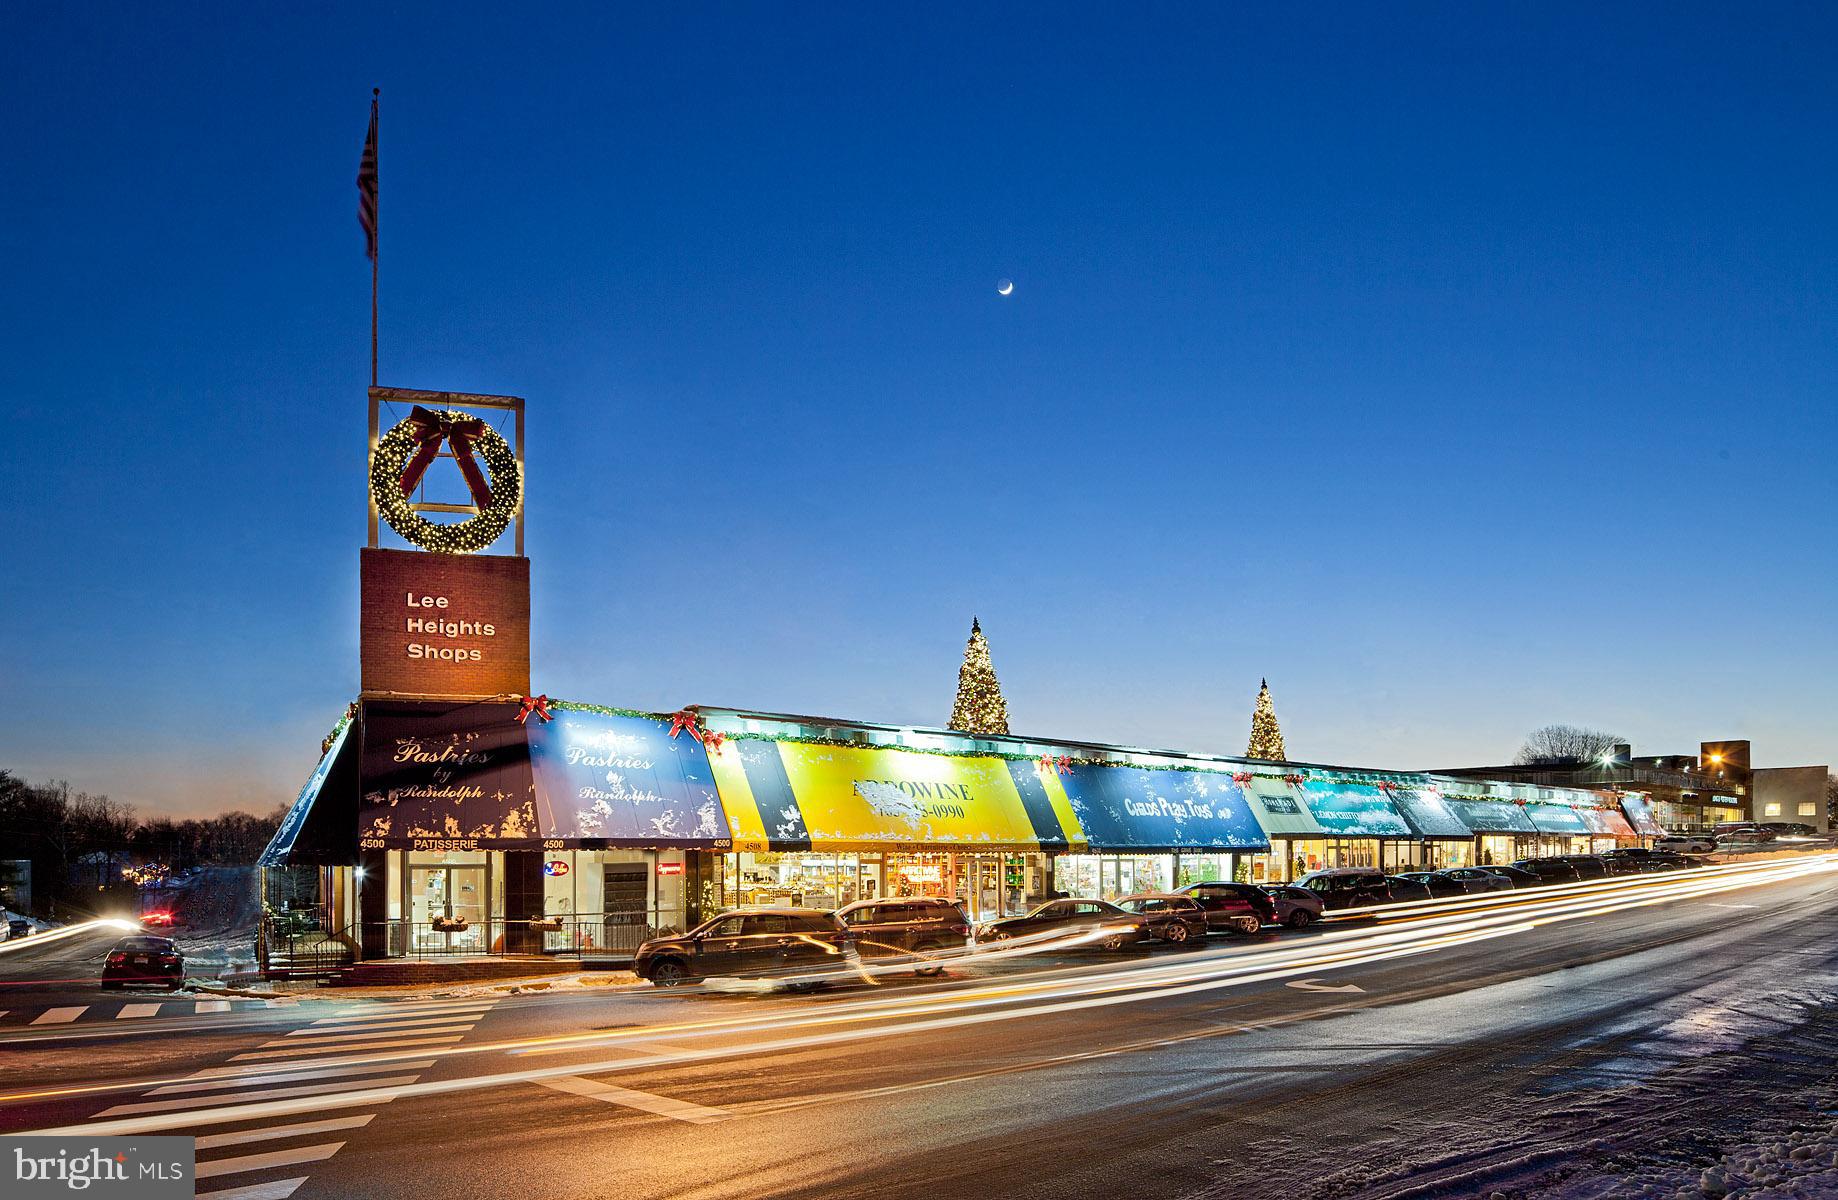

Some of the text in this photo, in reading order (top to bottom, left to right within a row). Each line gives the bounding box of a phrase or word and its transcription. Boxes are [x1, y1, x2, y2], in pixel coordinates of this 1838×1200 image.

[407, 592, 449, 608] Lee
[407, 618, 496, 638] Heights
[407, 643, 482, 663] Shops
[394, 743, 493, 764] Pastries
[566, 748, 656, 769] Pastries
[433, 767, 453, 783] by
[400, 785, 485, 802] Randolph
[579, 787, 658, 805] Randolph
[360, 839, 478, 849] 4500 PATISSERIE
[543, 839, 731, 849] 4500 4500
